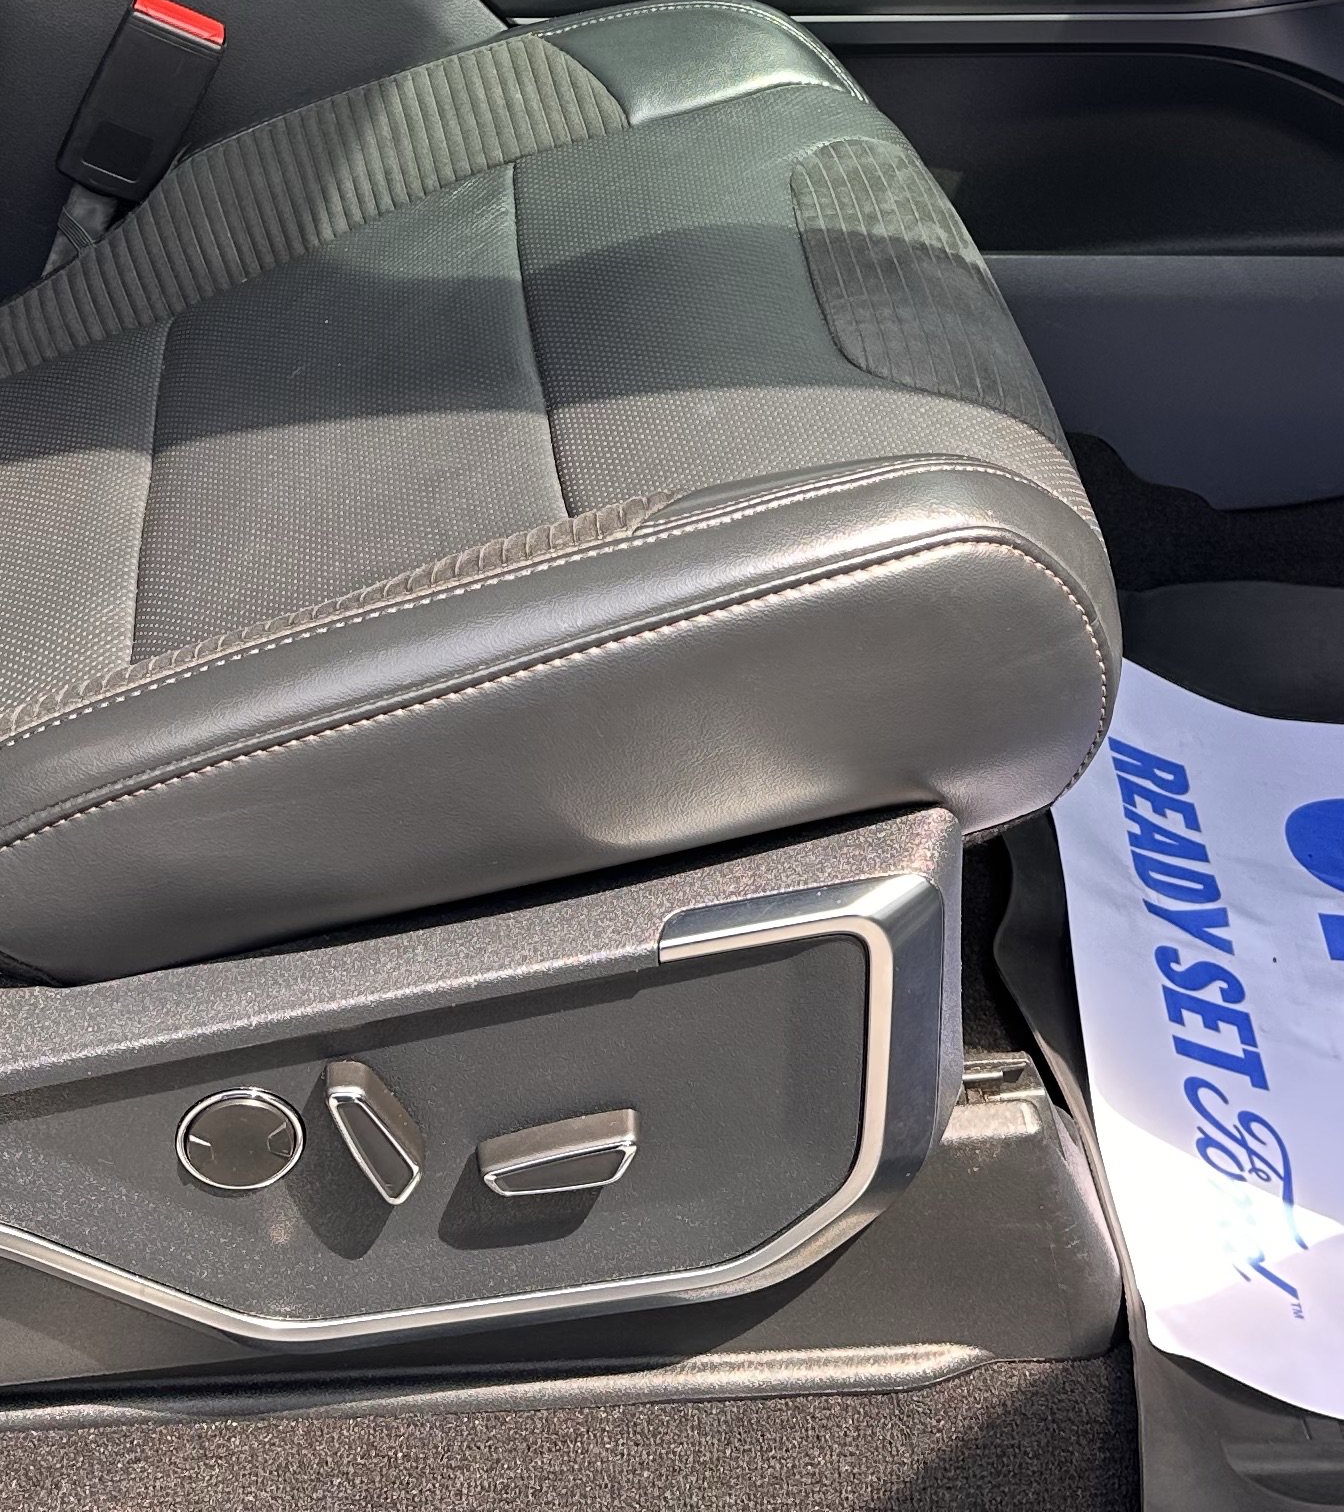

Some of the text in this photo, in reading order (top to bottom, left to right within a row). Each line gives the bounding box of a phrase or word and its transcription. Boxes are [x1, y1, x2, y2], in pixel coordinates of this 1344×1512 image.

[1108, 735, 1235, 956] READY
[1153, 944, 1270, 1092] SET
[1183, 1075, 1309, 1301] Fod
